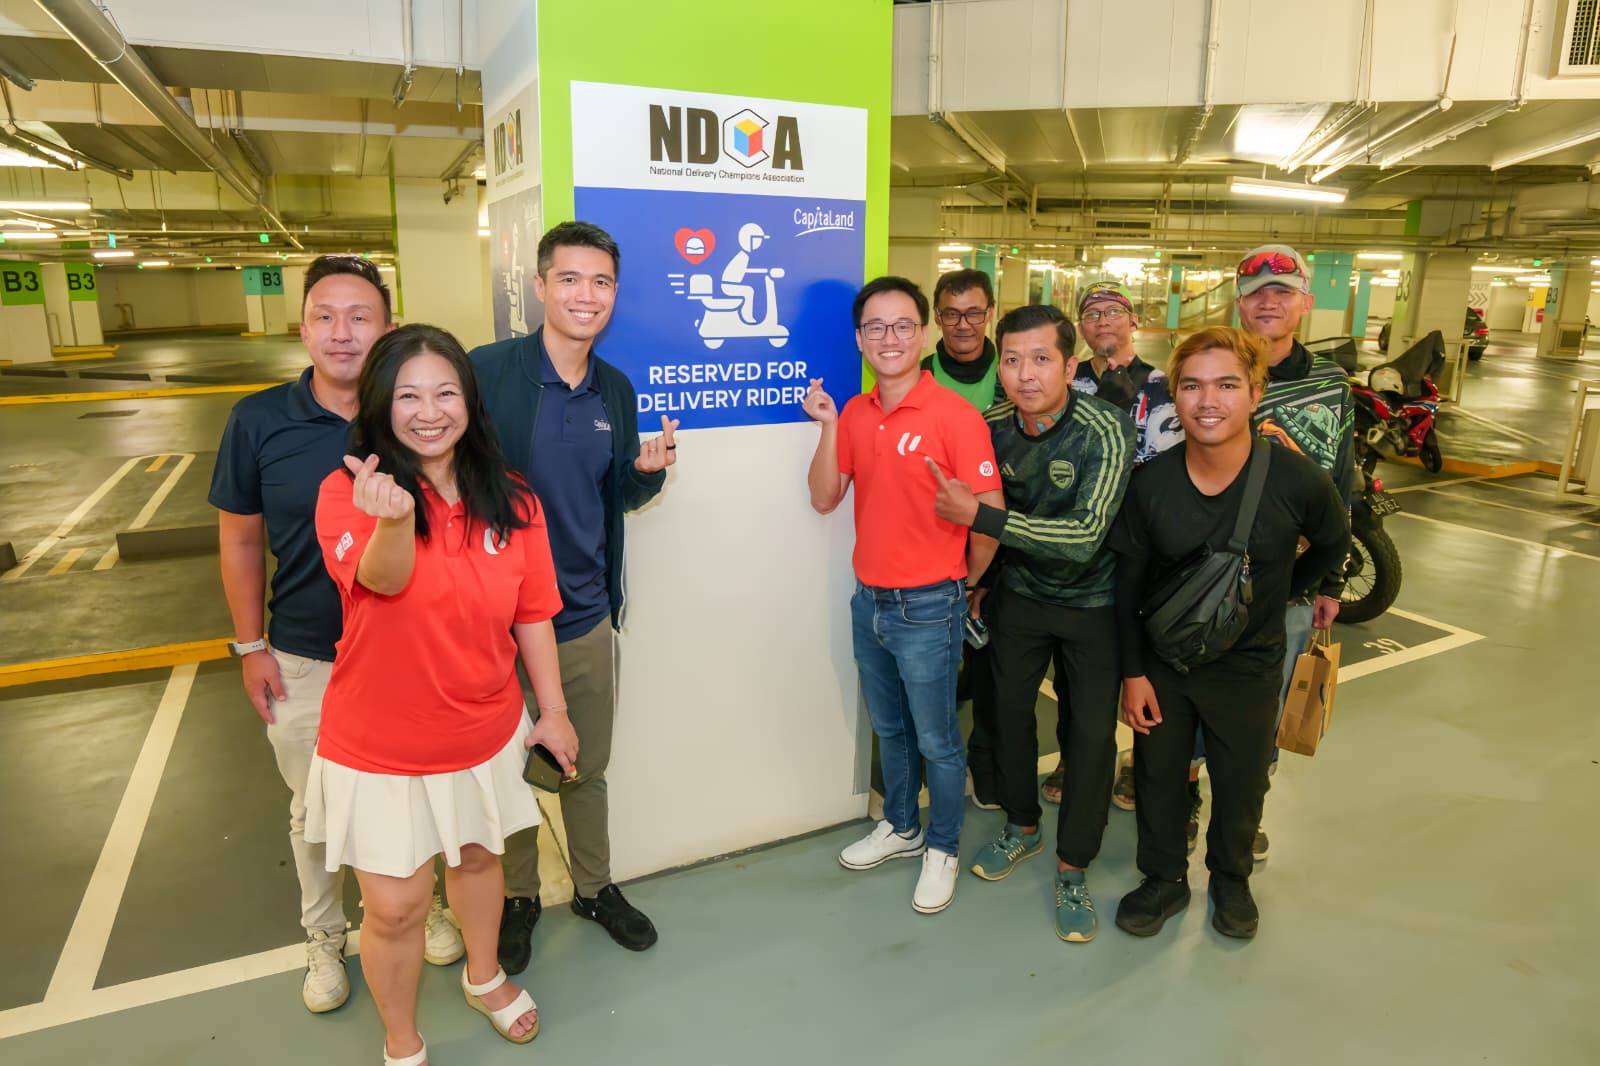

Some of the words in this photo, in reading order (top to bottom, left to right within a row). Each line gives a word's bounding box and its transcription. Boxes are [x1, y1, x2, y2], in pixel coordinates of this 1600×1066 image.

[650, 166, 683, 177] National
[686, 168, 717, 181] Delivery
[719, 170, 761, 182] Champions
[762, 172, 805, 183] Association
[793, 206, 854, 229] CapitaLand
[2, 270, 40, 293] B3
[67, 273, 95, 291] B3
[262, 272, 281, 287] B3
[1546, 287, 1559, 303] B3
[649, 362, 761, 384] RESERVED
[766, 361, 808, 380] FOR
[637, 389, 743, 412] DELIVERY
